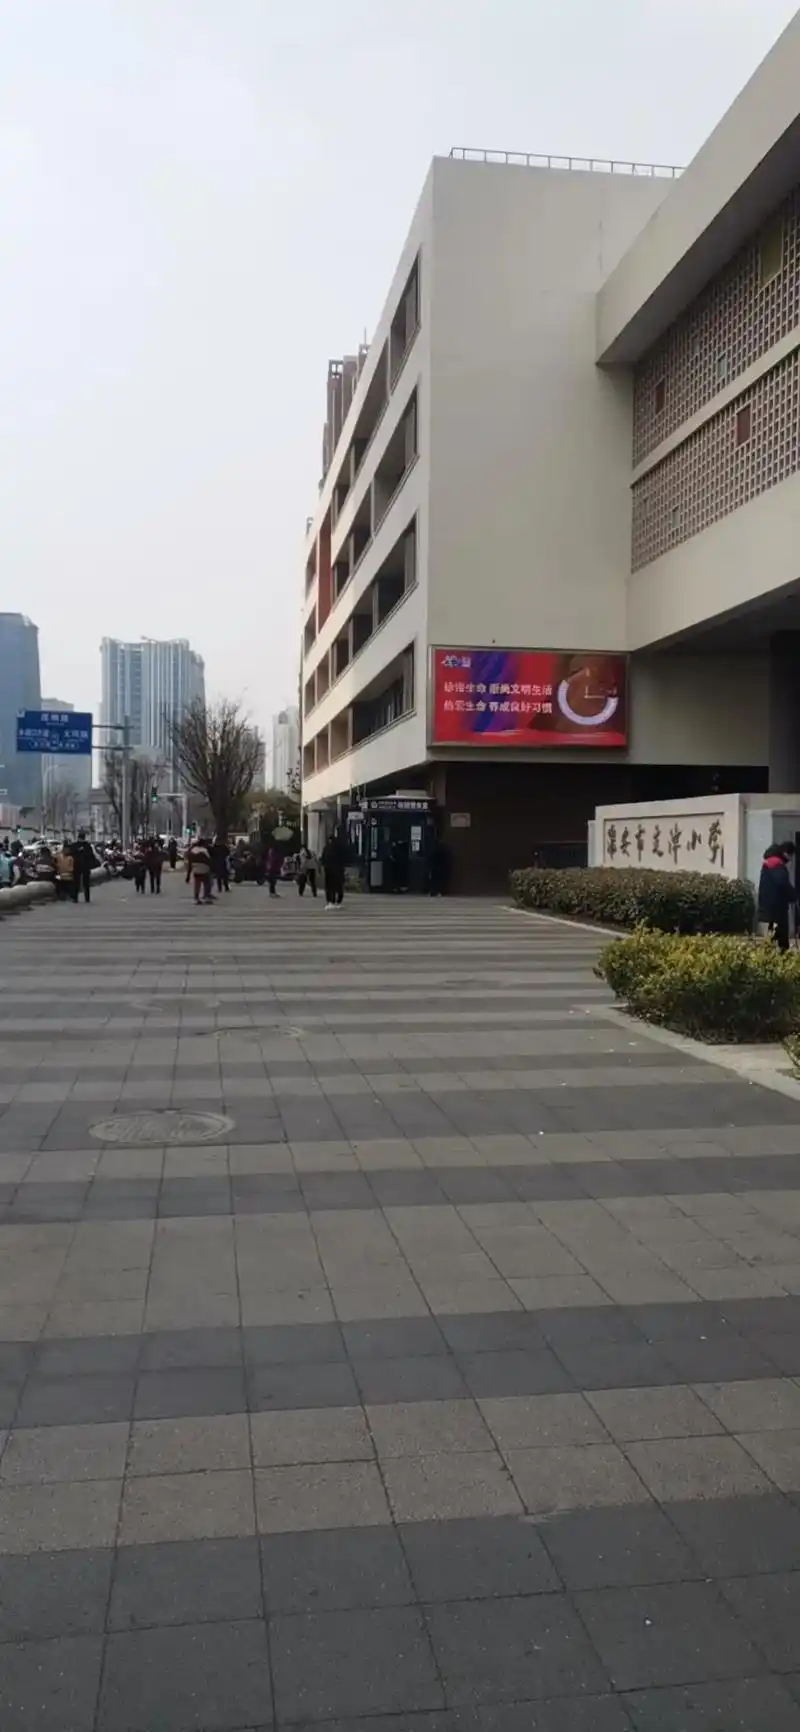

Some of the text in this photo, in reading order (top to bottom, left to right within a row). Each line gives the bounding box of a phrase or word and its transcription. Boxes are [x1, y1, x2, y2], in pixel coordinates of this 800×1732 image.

[489, 701, 552, 713] 养成良好习惯
